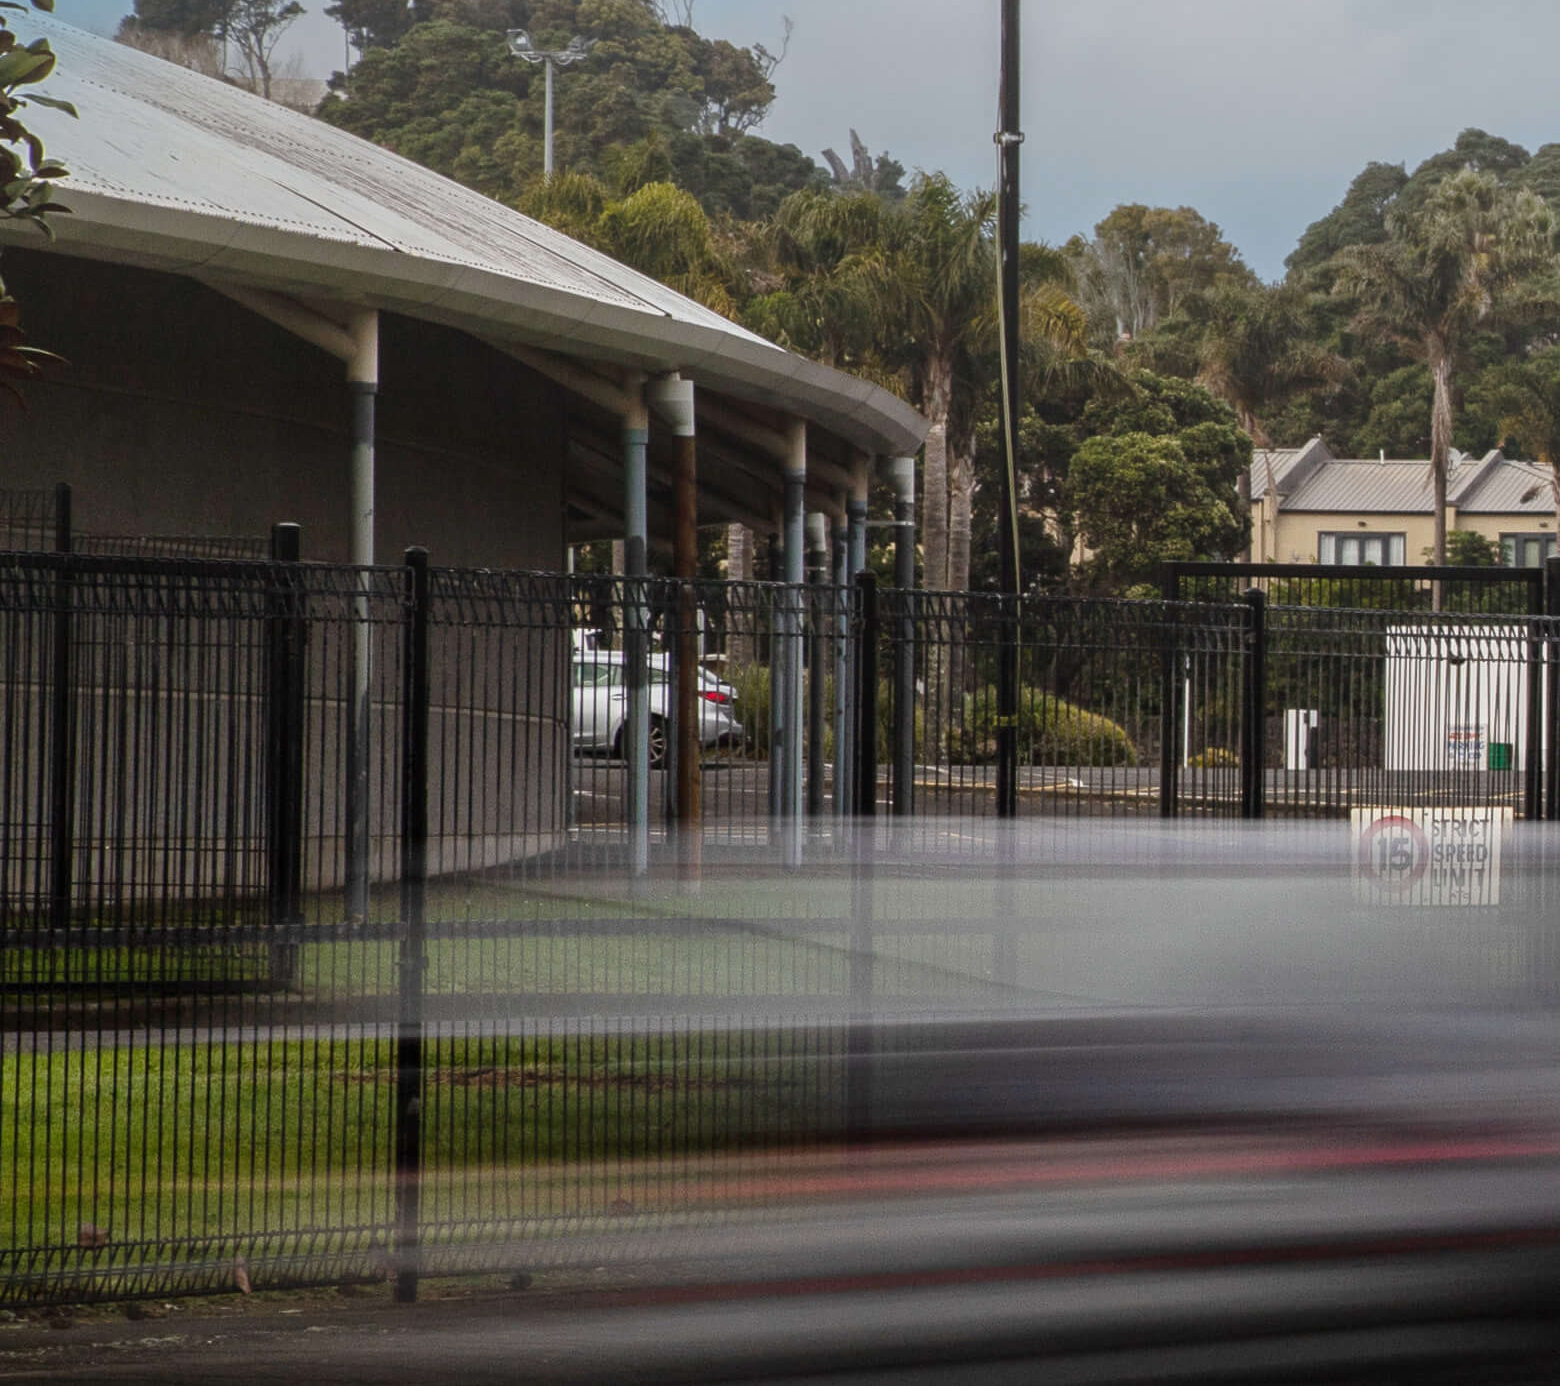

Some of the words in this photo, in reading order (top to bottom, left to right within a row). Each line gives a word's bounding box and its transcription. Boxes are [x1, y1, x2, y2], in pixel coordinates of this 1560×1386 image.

[1432, 819, 1489, 837] STRICT
[1377, 837, 1411, 870] 15
[1434, 844, 1488, 863] SPEED
